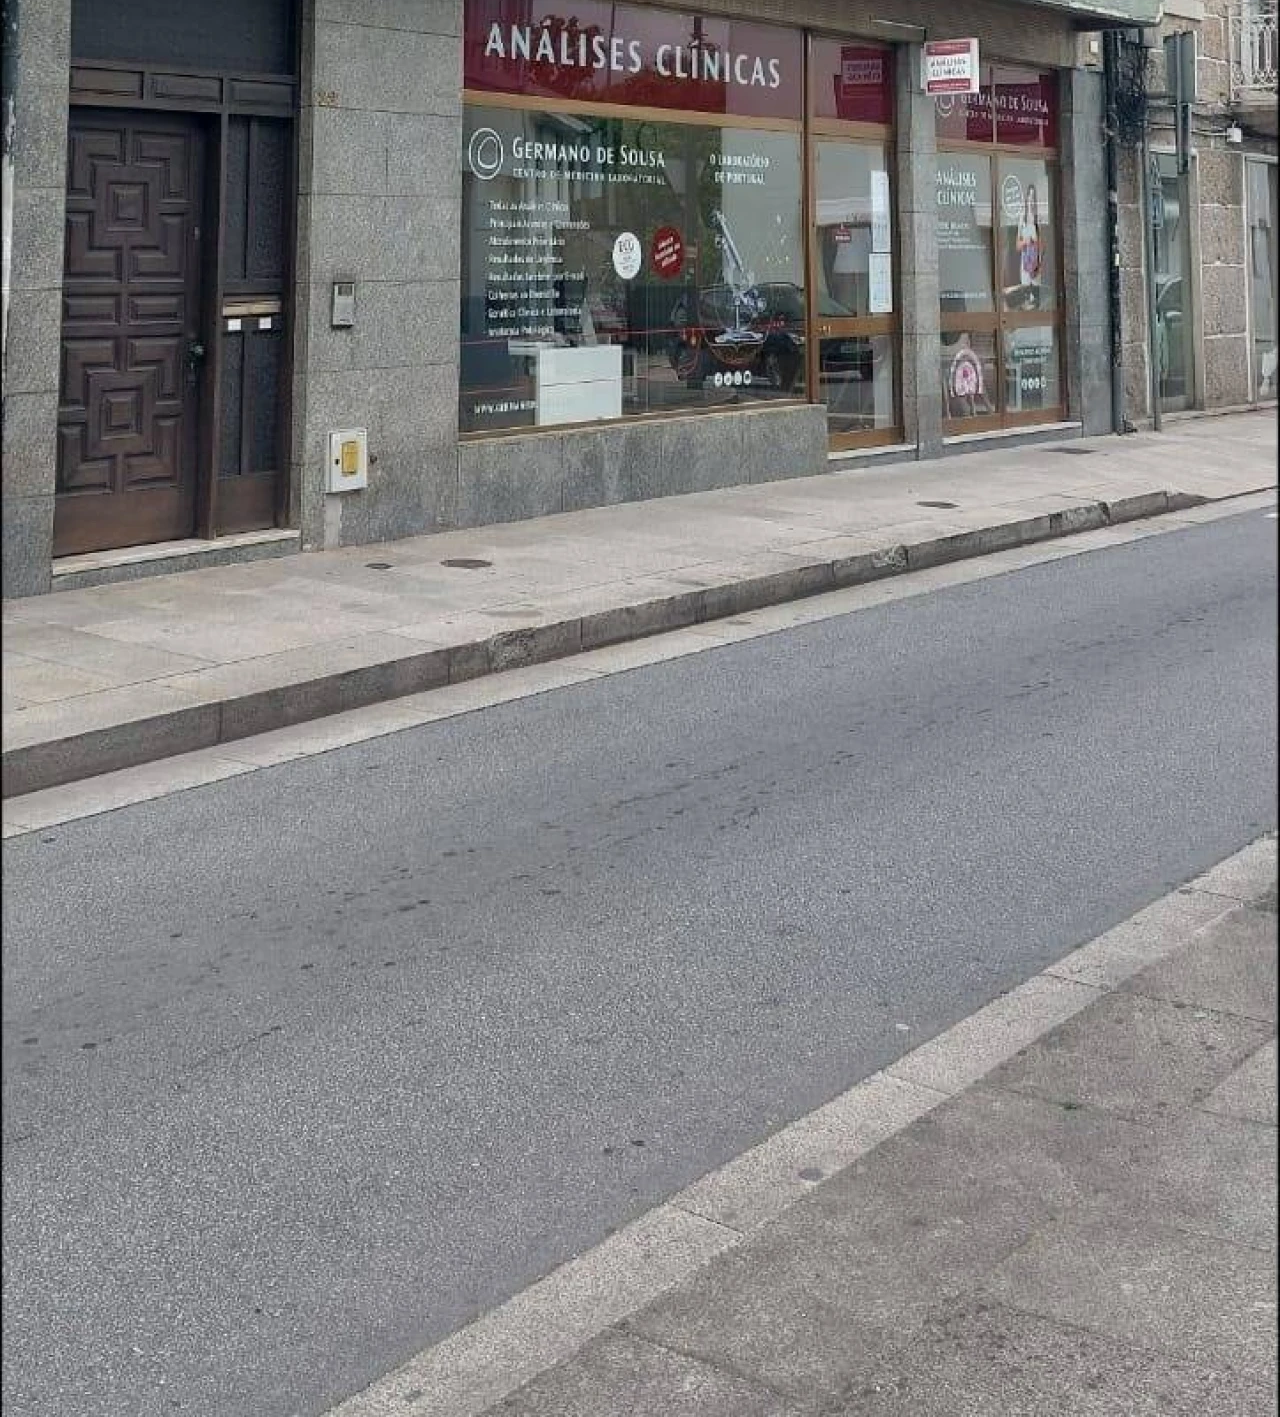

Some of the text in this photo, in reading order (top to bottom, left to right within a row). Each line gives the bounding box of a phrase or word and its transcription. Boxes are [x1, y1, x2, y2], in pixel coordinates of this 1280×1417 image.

[484, 19, 781, 89] ANÁLISES CLÍNICAS
[512, 136, 666, 168] GERMANO DE SOUSA
